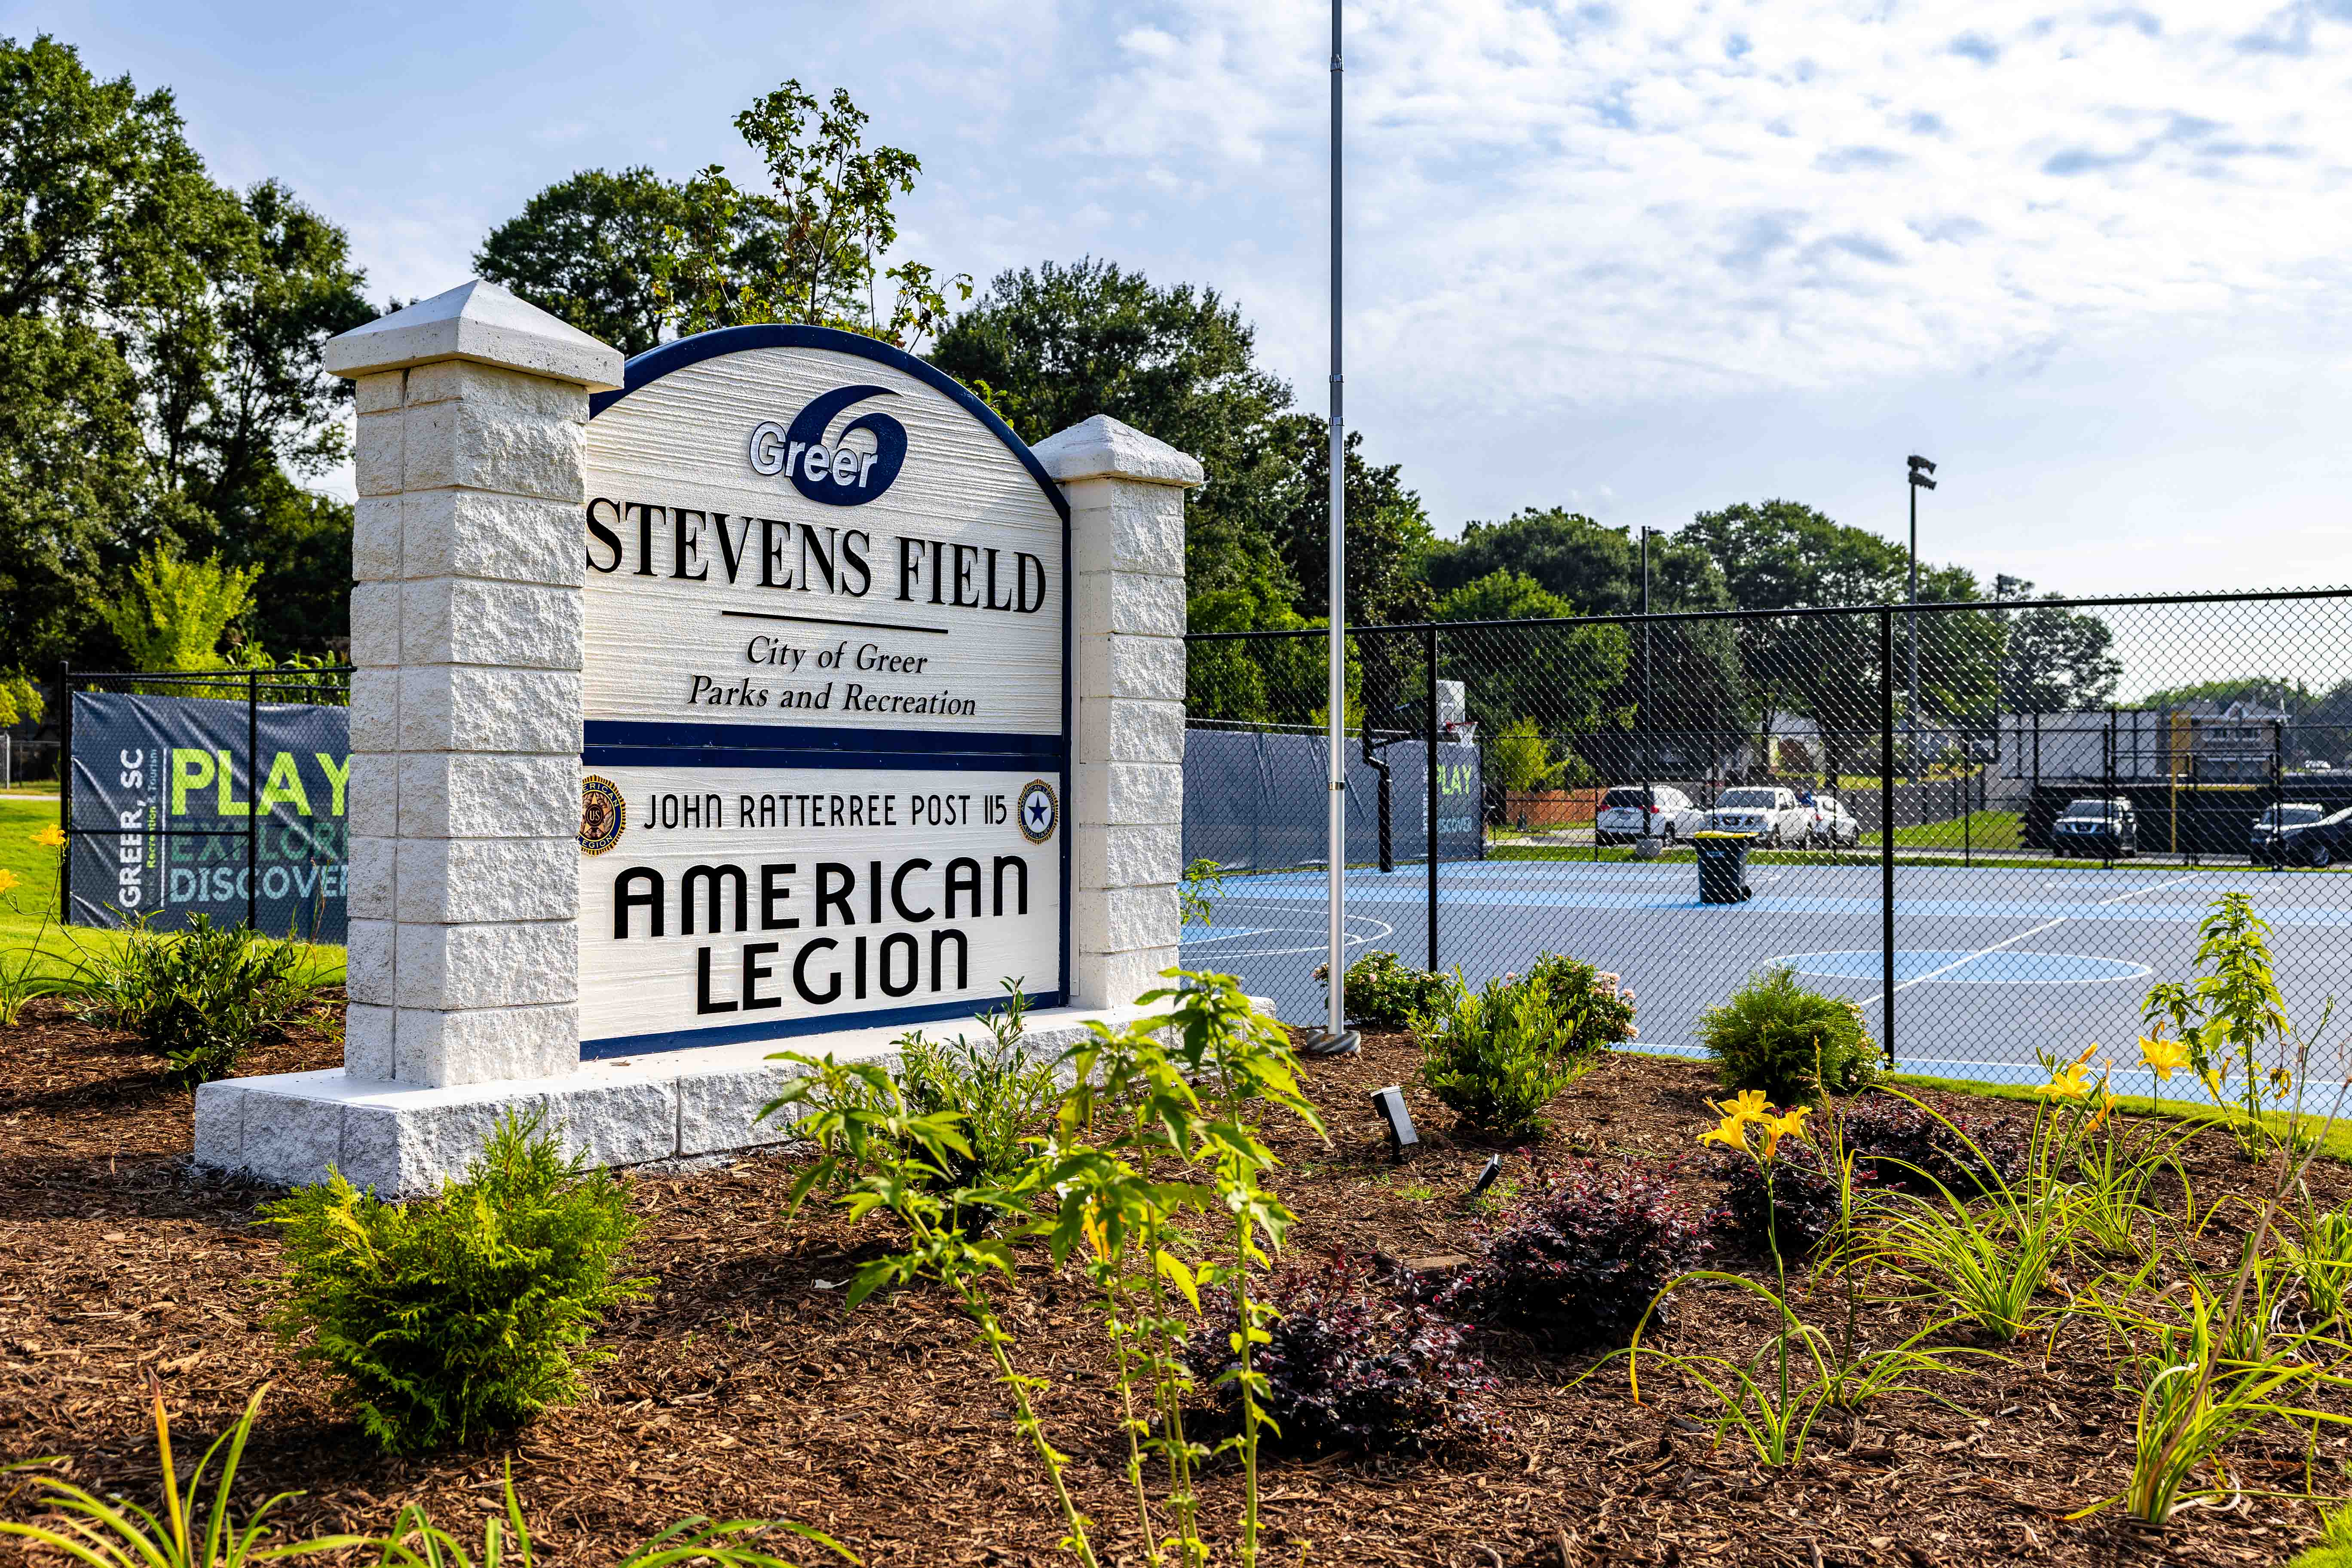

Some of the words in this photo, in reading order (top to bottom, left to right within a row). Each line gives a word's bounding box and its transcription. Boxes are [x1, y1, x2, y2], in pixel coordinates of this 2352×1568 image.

[749, 421, 878, 488] Greer
[585, 497, 872, 598] STEVENS
[895, 536, 1047, 614] FIELD
[747, 635, 807, 672] City
[818, 641, 848, 668] of
[857, 643, 928, 674] Greer
[687, 675, 769, 707] Parks
[780, 682, 833, 709] and
[842, 683, 976, 716] Recreation
[120, 748, 144, 789] SC
[172, 748, 355, 816] PLAY
[582, 782, 619, 807] ERICAN
[643, 793, 722, 829] JOHN
[740, 793, 897, 828] RATTERREE
[912, 794, 971, 826] POST
[985, 795, 1007, 825] 115
[1020, 785, 1042, 812] AMERICAN
[1043, 786, 1055, 812] LEGION
[1023, 824, 1050, 839] AUXILIARY
[118, 799, 147, 908] GREER,
[614, 855, 1028, 940] AMERICAN
[697, 928, 968, 1015] LEGION
